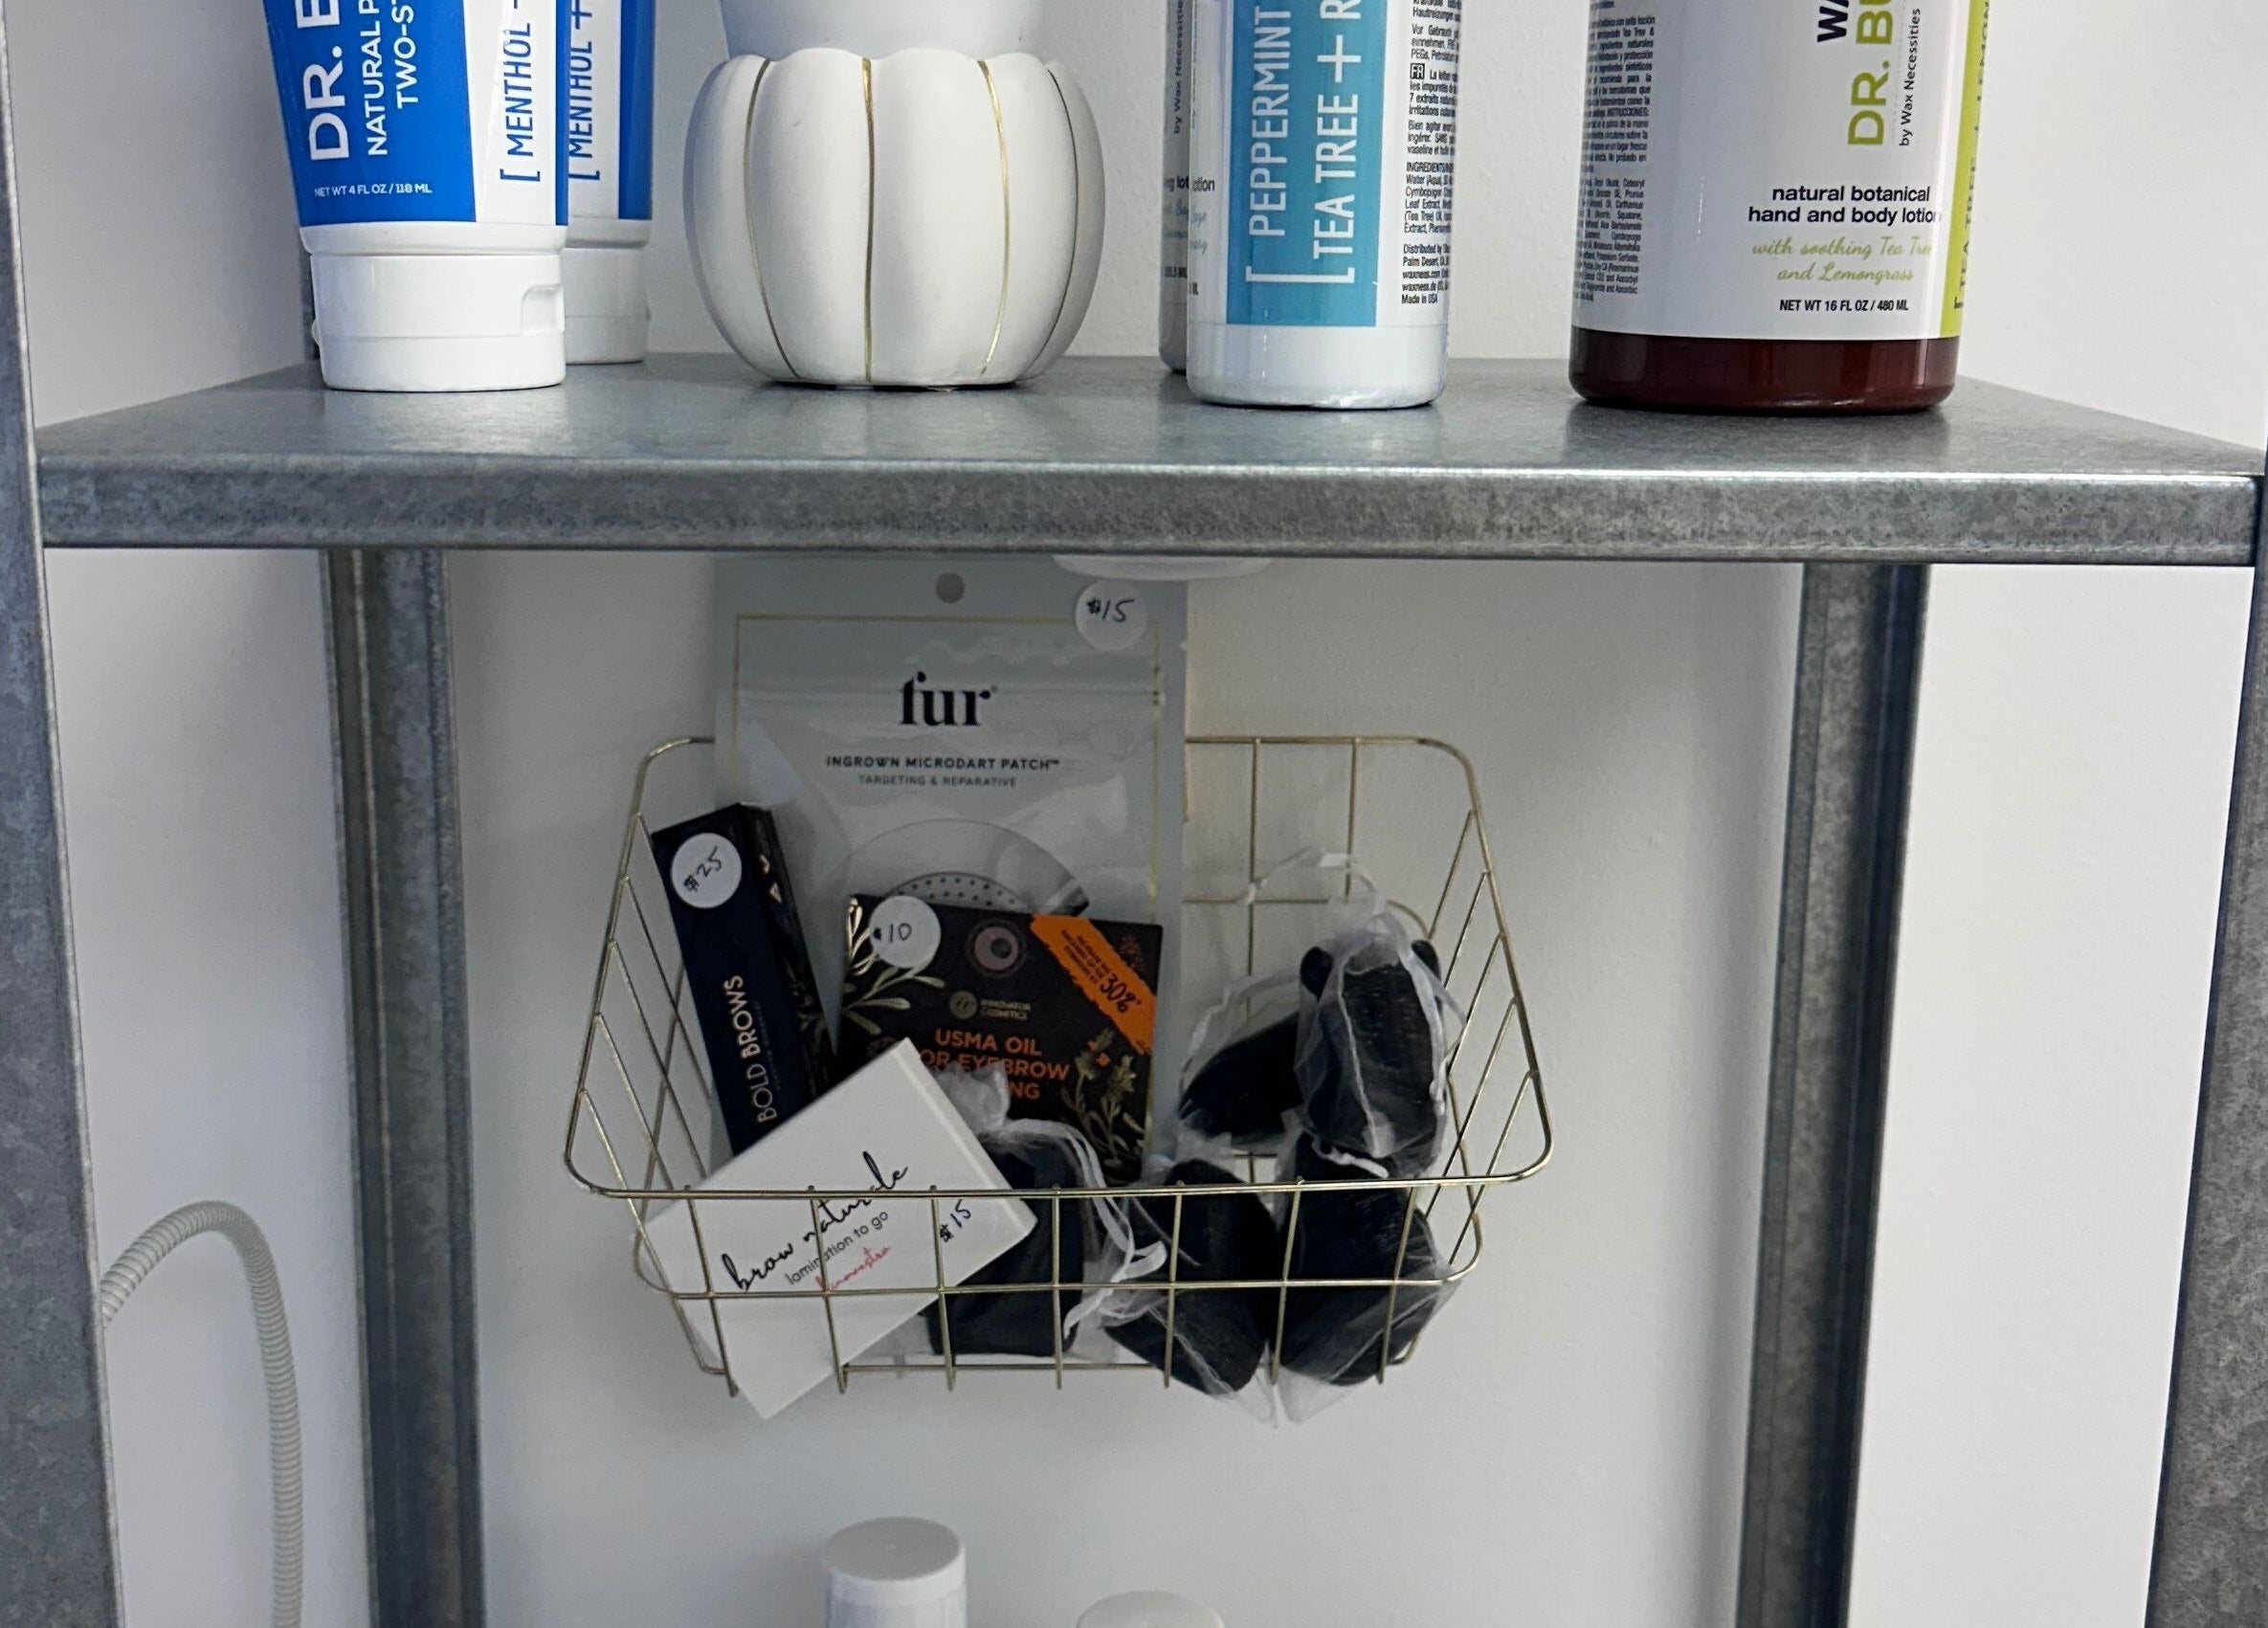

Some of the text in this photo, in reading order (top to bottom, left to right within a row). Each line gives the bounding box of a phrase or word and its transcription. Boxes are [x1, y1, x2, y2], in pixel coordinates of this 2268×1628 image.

[390, 0, 419, 109] TWO-S
[1848, 0, 1893, 145] DR. B
[1899, 8, 1922, 146] by Wax Necessities
[303, 46, 349, 160] DR.
[360, 20, 388, 156] NATURAL
[503, 23, 534, 157] MENTHOL
[1249, 6, 1292, 236] PEPPERMINT
[1315, 94, 1359, 184] TREE
[314, 187, 330, 197] NET
[331, 186, 347, 196] WT
[348, 185, 356, 195] 4
[357, 184, 370, 195] FL
[371, 183, 388, 194] OZ
[395, 183, 412, 193] 118
[414, 183, 433, 193] ML
[1747, 206, 1801, 223] hand
[1807, 206, 1845, 223] and
[1852, 207, 1898, 227] body
[1772, 186, 1931, 202] natural botanical
[1313, 194, 1355, 259] TEA
[1752, 236, 1794, 256] with
[1799, 236, 1872, 259] soothing
[1777, 261, 1914, 286] and Lemongrass
[1779, 300, 1802, 311] NET
[1805, 300, 1822, 311] WT
[1824, 300, 1837, 312] 16
[1840, 300, 1853, 311] FL
[1855, 300, 1869, 311] OZ
[1896, 300, 1909, 311] ML
[900, 671, 991, 726] fur
[827, 756, 900, 768] INGROWN
[905, 757, 996, 769] MICRODART
[859, 774, 1016, 787] TARGETING & REPARATIVE
[723, 974, 762, 1059] BROWS
[935, 1028, 1042, 1057] USMA OIL
[920, 1050, 951, 1067] OR
[745, 1062, 778, 1124] BOLD
[854, 1224, 869, 1239] to
[871, 1210, 889, 1230] go
[722, 1241, 793, 1292] brow
